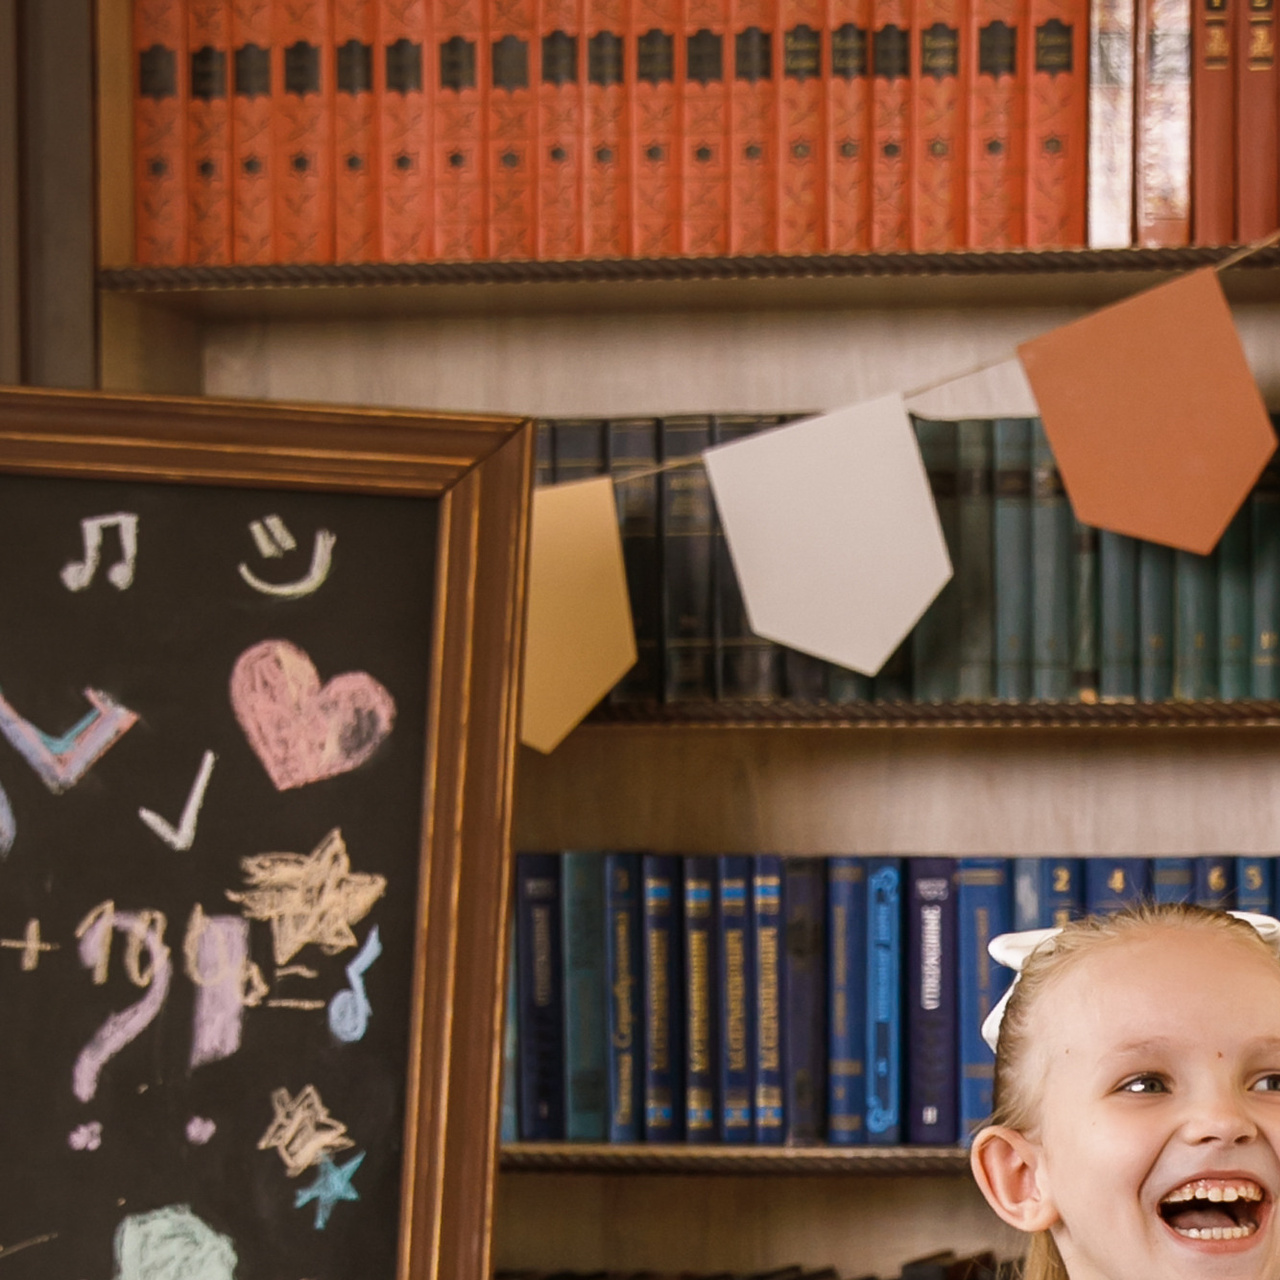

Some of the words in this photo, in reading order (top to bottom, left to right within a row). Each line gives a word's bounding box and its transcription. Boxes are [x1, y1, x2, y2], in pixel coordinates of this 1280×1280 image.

[1052, 866, 1071, 892] 2
[1107, 868, 1126, 893] 4
[1207, 866, 1227, 892] 6
